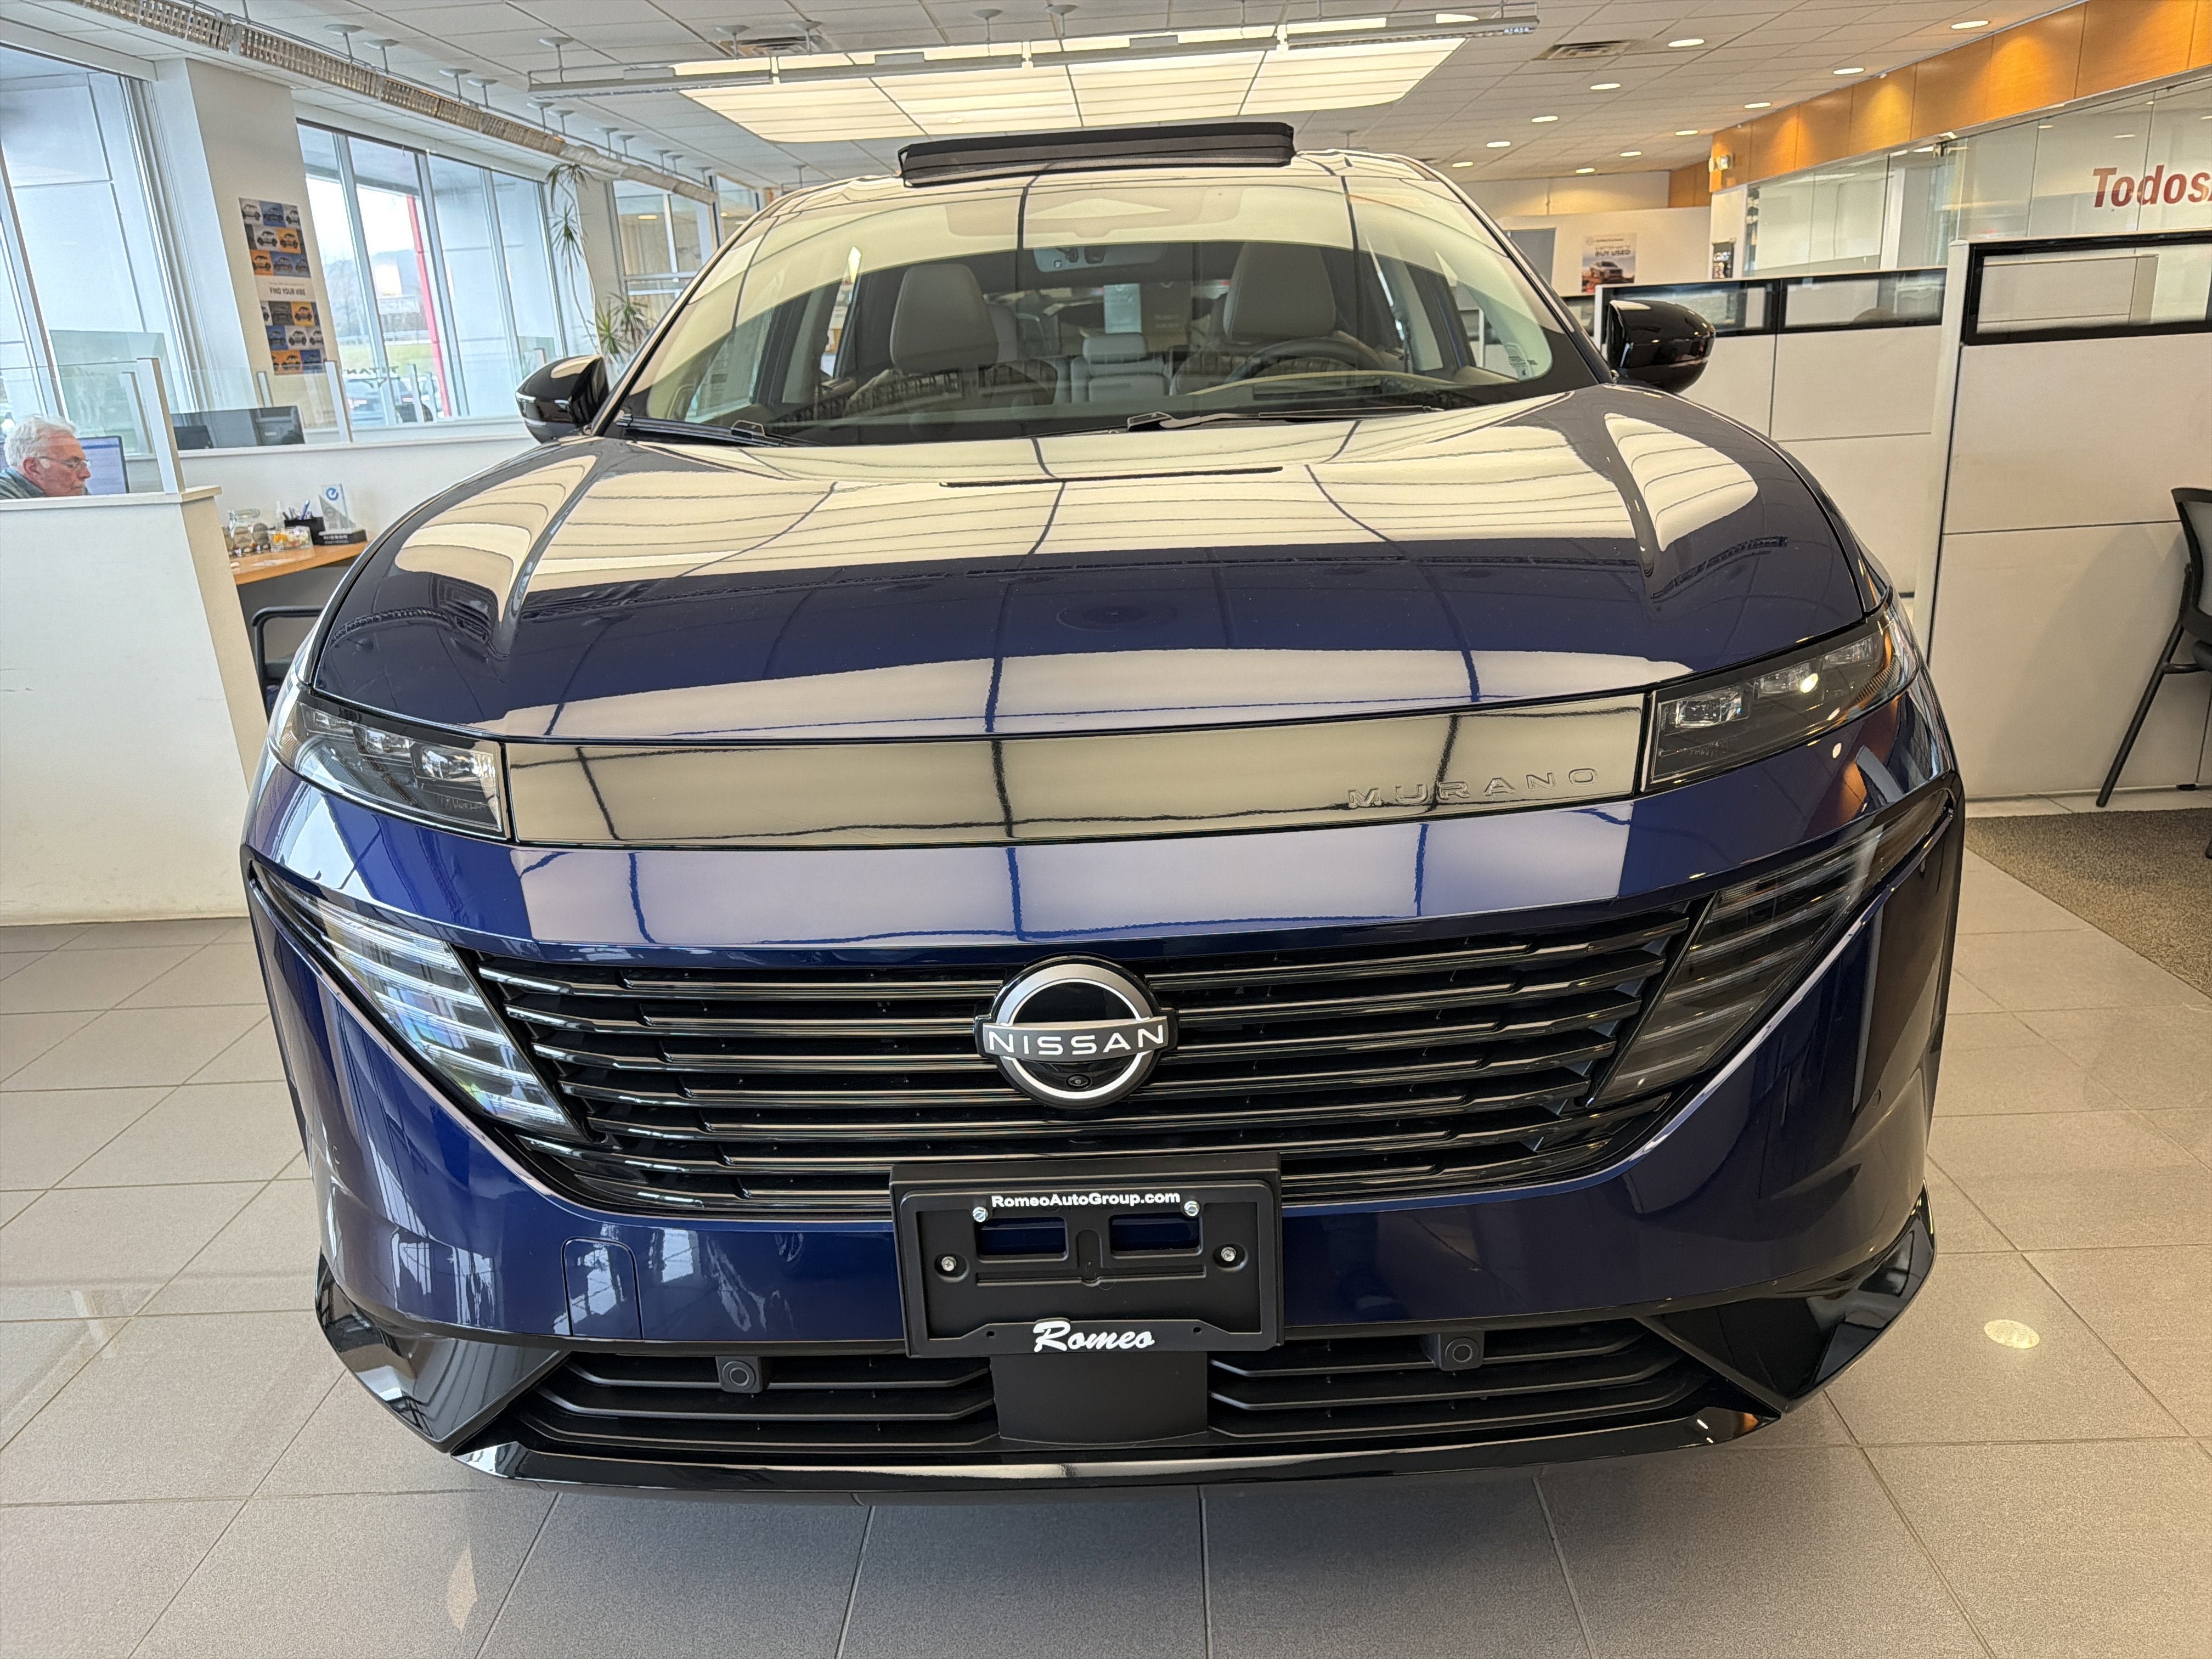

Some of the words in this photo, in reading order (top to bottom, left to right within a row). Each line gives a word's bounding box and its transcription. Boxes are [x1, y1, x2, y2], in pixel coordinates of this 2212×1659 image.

[282, 287, 295, 295] YOUR
[1347, 767, 1598, 808] MURANO
[989, 1024, 1164, 1056] NISSAN
[991, 1192, 1181, 1207] RomeoAutoGroup.com
[1032, 1320, 1155, 1353] Romeo
